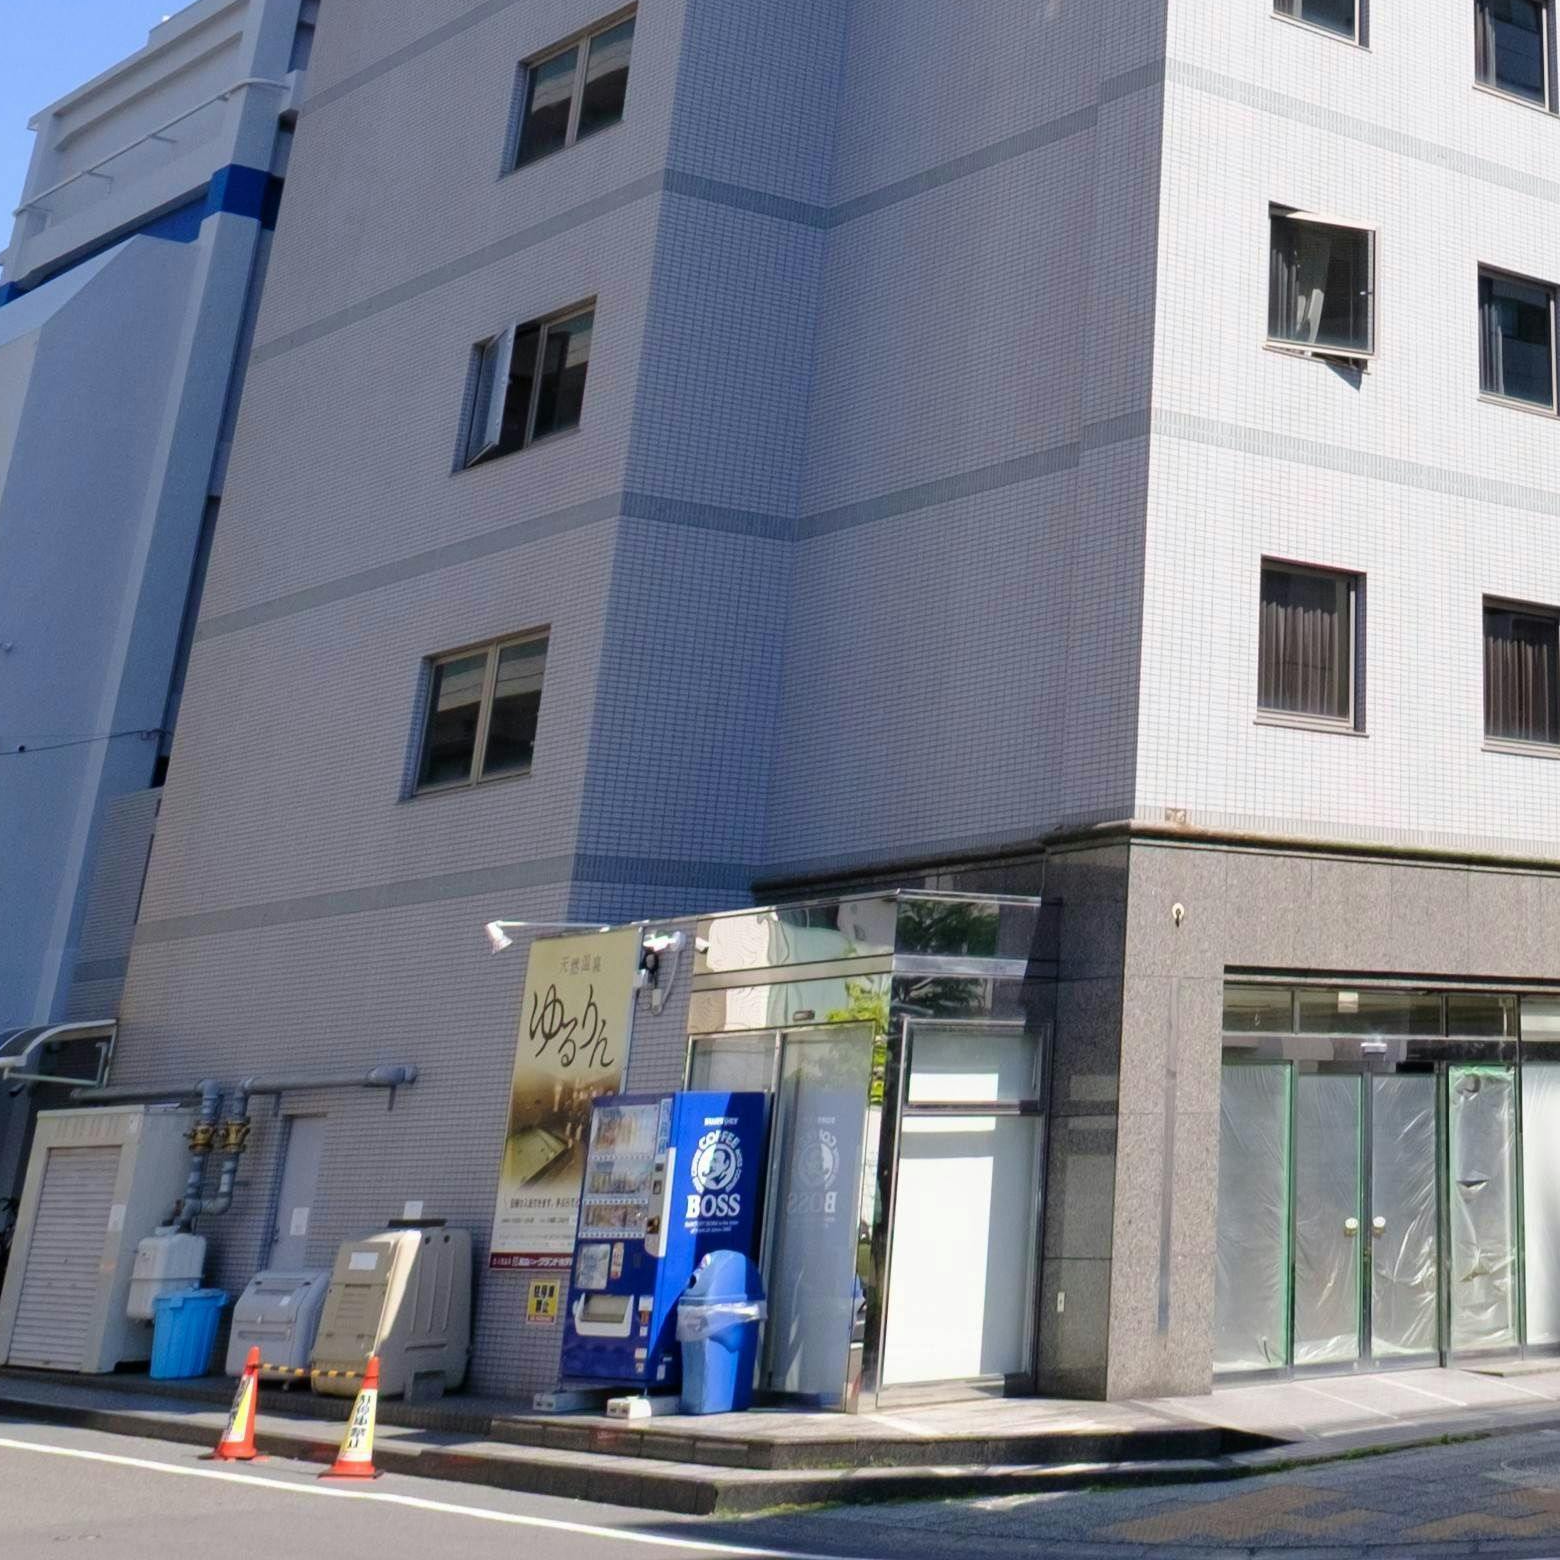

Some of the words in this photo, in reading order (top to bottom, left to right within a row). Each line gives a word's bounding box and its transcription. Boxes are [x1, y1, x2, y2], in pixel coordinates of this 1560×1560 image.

[529, 984, 616, 1069] ゆるりん
[685, 1193, 741, 1219] BOSS
